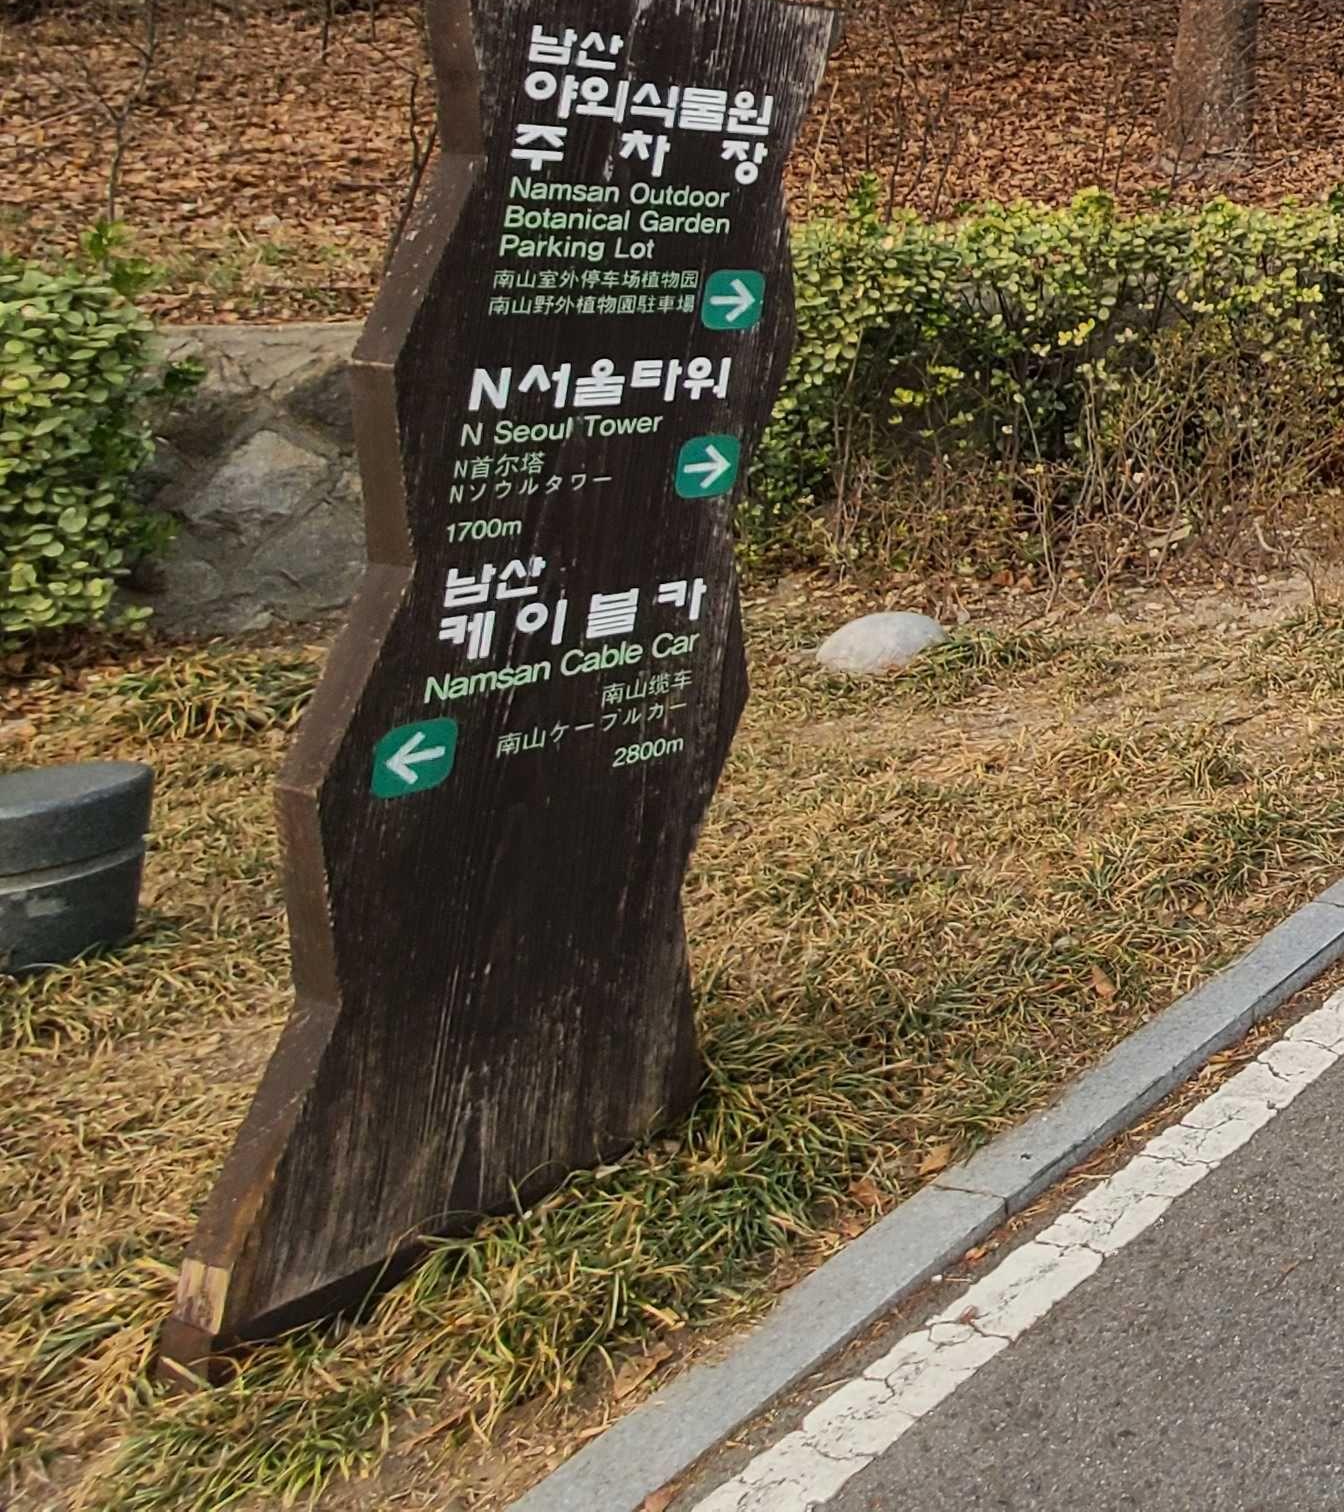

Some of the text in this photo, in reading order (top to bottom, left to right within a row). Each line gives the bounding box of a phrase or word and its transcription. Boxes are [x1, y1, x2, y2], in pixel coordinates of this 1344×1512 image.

[528, 24, 624, 70] 남산
[523, 72, 774, 136] 야외식물원
[509, 176, 731, 208] Namsan Outdoor
[503, 206, 731, 235] Botanical Garden
[499, 234, 656, 262] Parking Lot
[493, 269, 700, 289] 南山室外停车场植物园
[468, 356, 732, 412] N서울타워
[460, 412, 665, 447] N Seoul Tower
[453, 451, 546, 480] N首尔塔
[446, 517, 523, 544] 1700m
[443, 556, 546, 608] 남산
[423, 632, 700, 704] Namsan Cable Car
[600, 669, 694, 709] 南山缆车
[612, 736, 685, 768] 2800m
